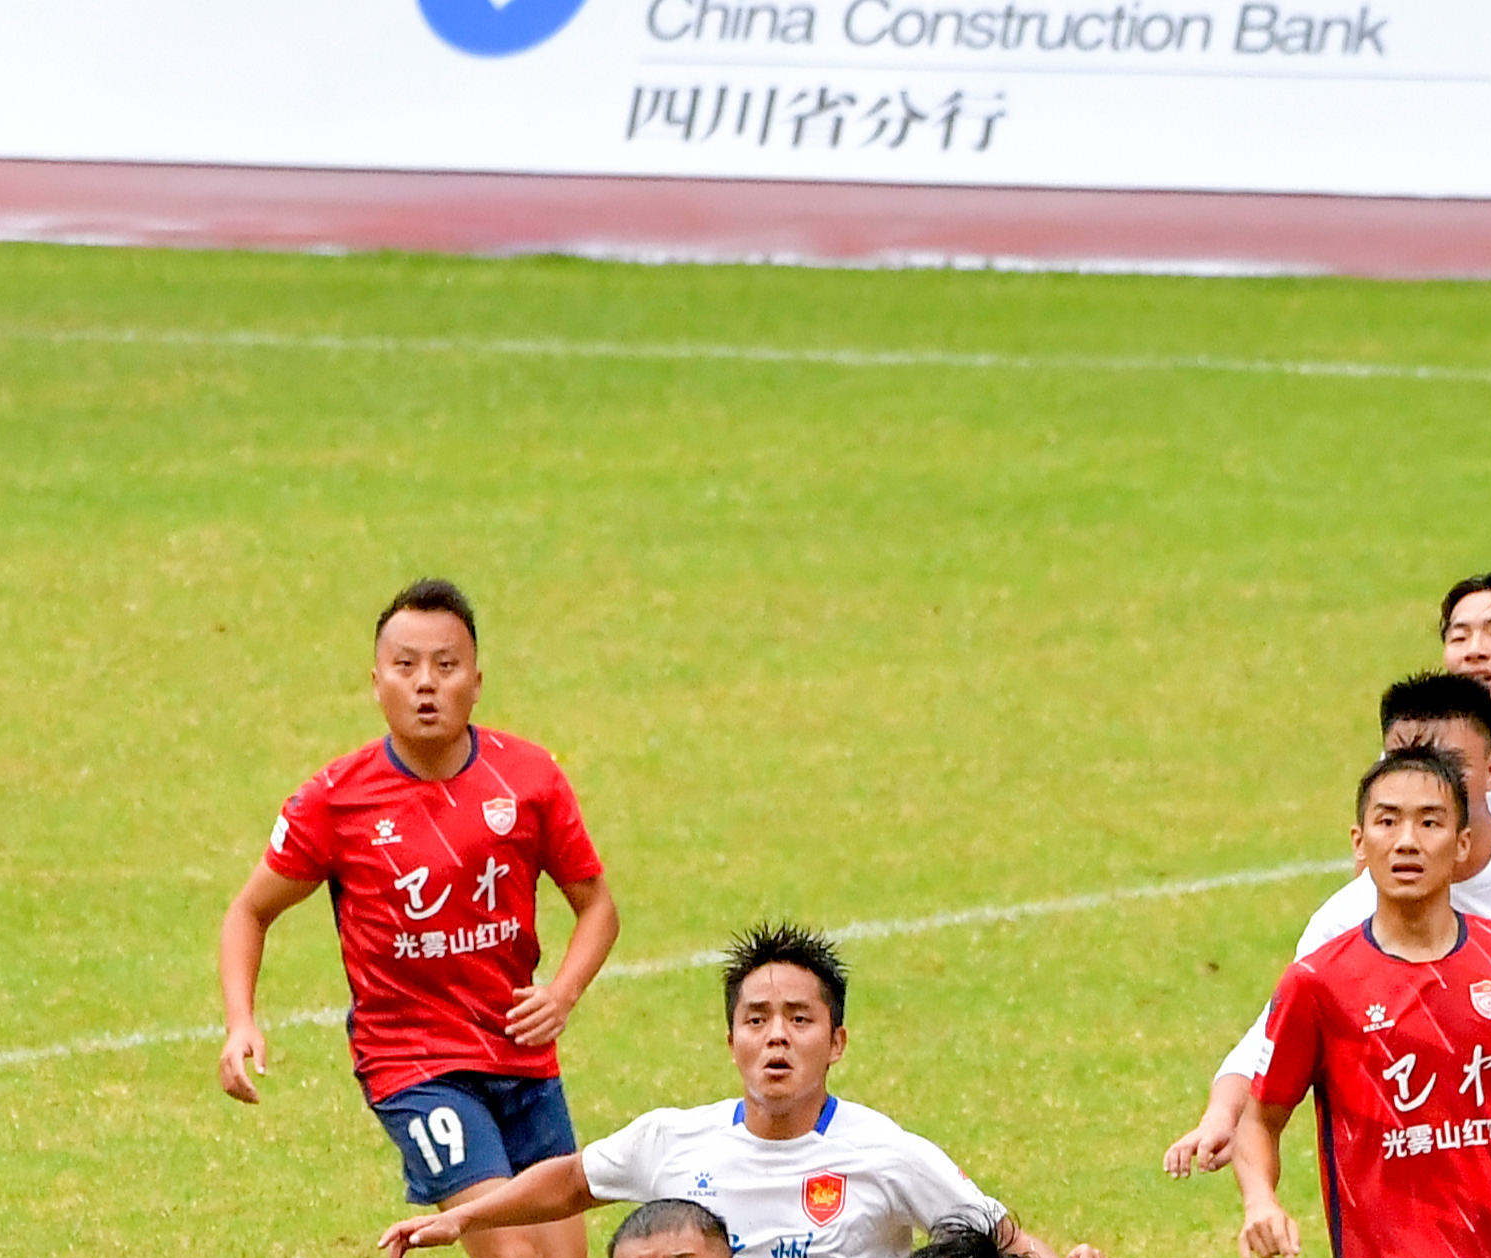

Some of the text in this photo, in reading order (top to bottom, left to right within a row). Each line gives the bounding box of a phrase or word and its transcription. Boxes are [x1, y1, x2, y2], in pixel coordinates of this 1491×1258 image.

[646, 0, 1388, 56] China Construction Bank
[624, 84, 1006, 152] 四川省分行
[393, 916, 521, 960] 光雾山红叶
[408, 1106, 465, 1175] 19
[687, 1190, 718, 1198] KELME
